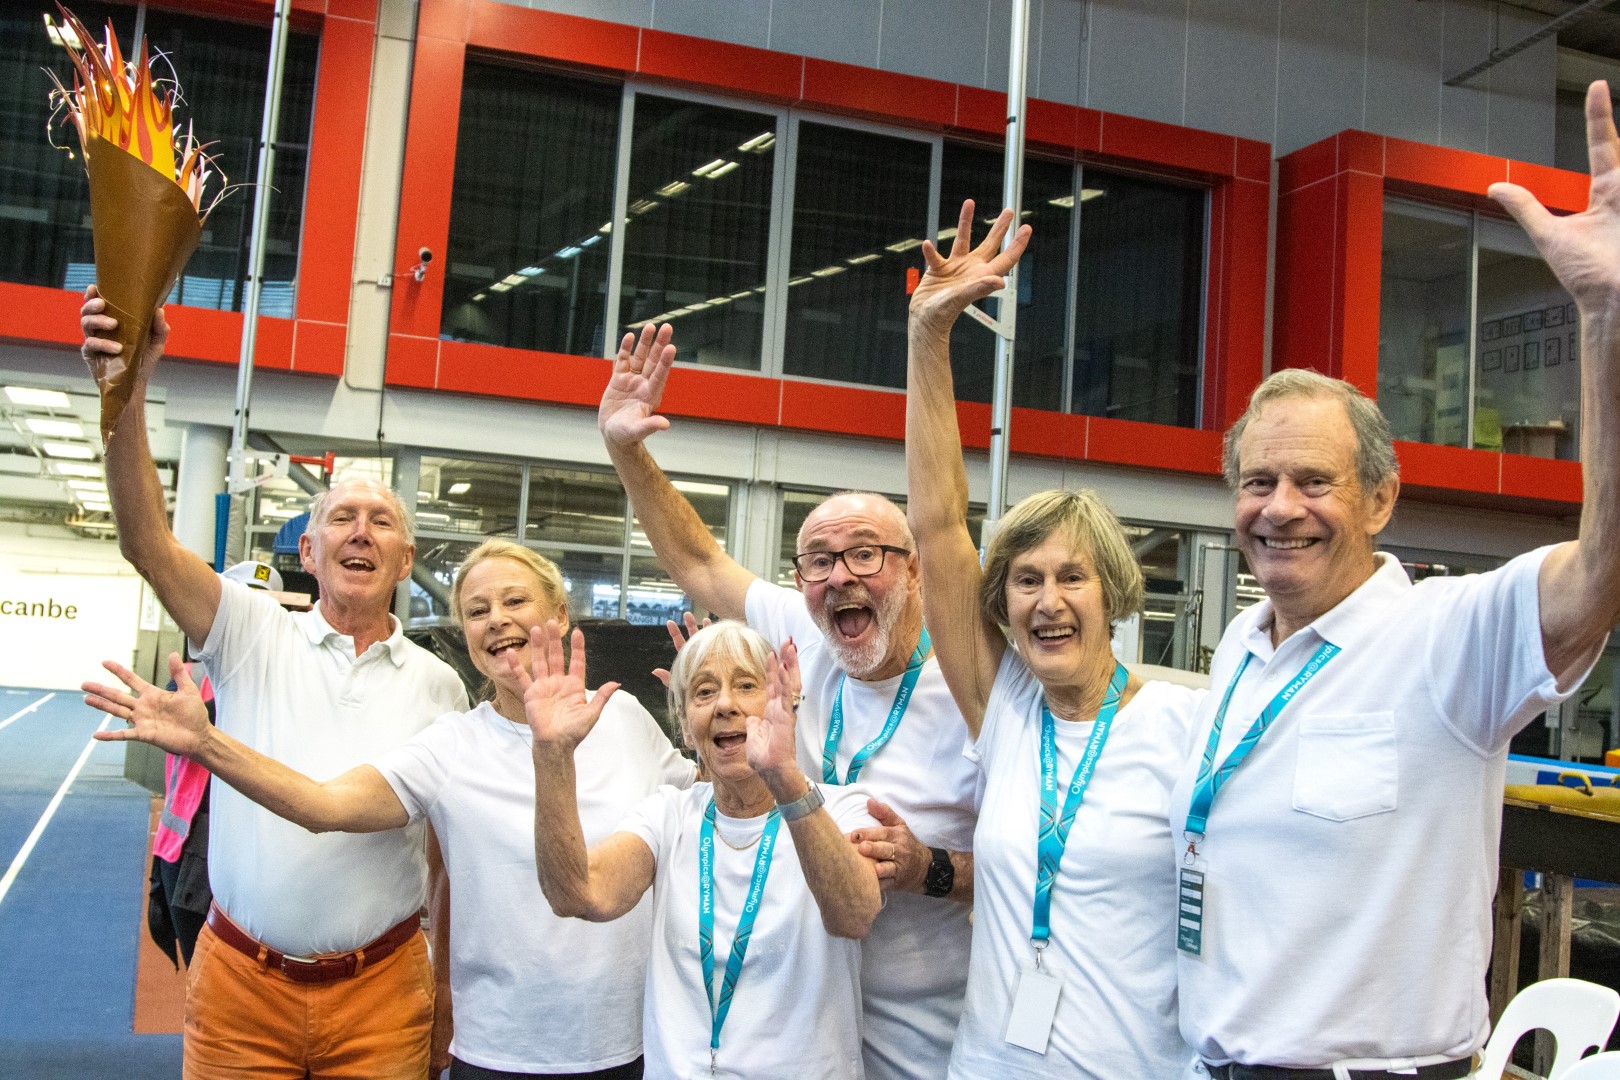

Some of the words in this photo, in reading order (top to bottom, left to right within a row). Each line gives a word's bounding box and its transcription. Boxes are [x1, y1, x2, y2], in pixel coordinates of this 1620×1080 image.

[0, 598, 78, 620] canbe
[1281, 644, 1336, 700] pics@RYMAN
[866, 686, 909, 751] Olympics@RYMAN
[1071, 721, 1107, 795] Olympics@RYMAN
[701, 837, 711, 914] Olympics@RYMAN
[745, 835, 772, 913] Olympics@RYMAN
